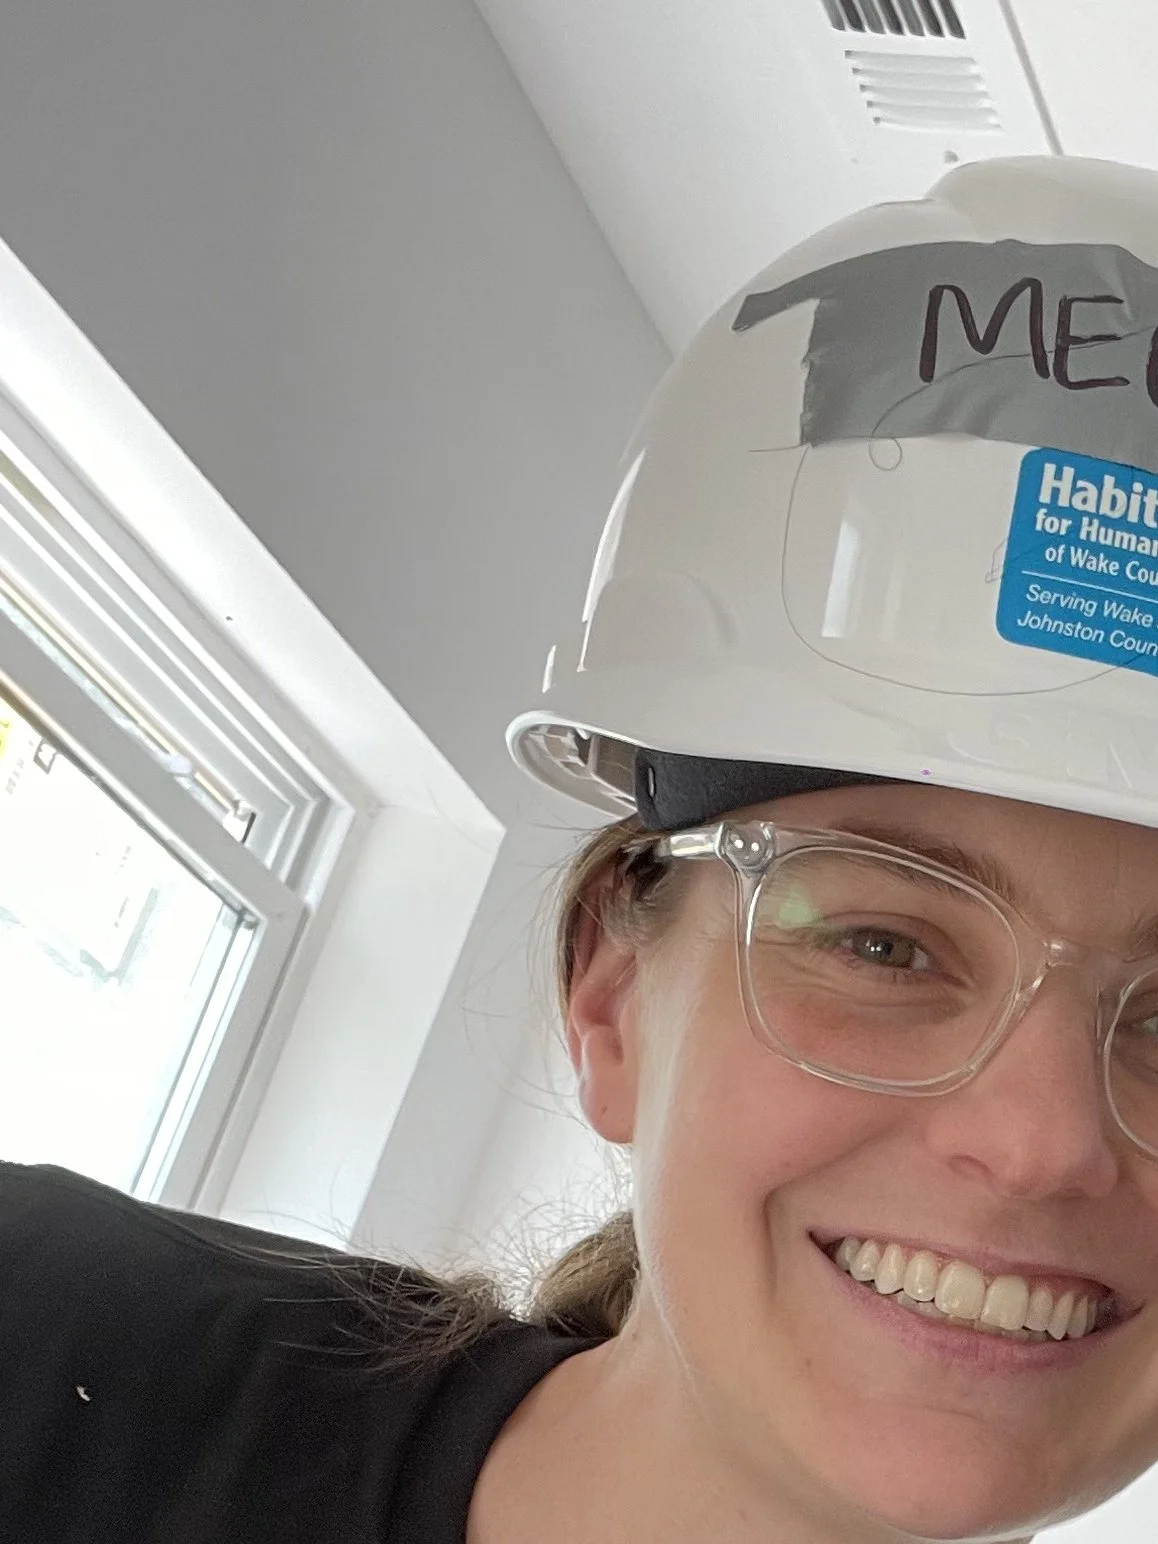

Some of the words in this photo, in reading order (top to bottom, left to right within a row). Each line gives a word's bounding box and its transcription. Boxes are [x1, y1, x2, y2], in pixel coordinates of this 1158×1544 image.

[1035, 508, 1073, 536] for
[1045, 544, 1066, 563] of
[1070, 546, 1120, 576] Wake
[1026, 583, 1098, 618] Serving
[1103, 600, 1154, 628] Wake
[1017, 610, 1105, 643] Johnston
